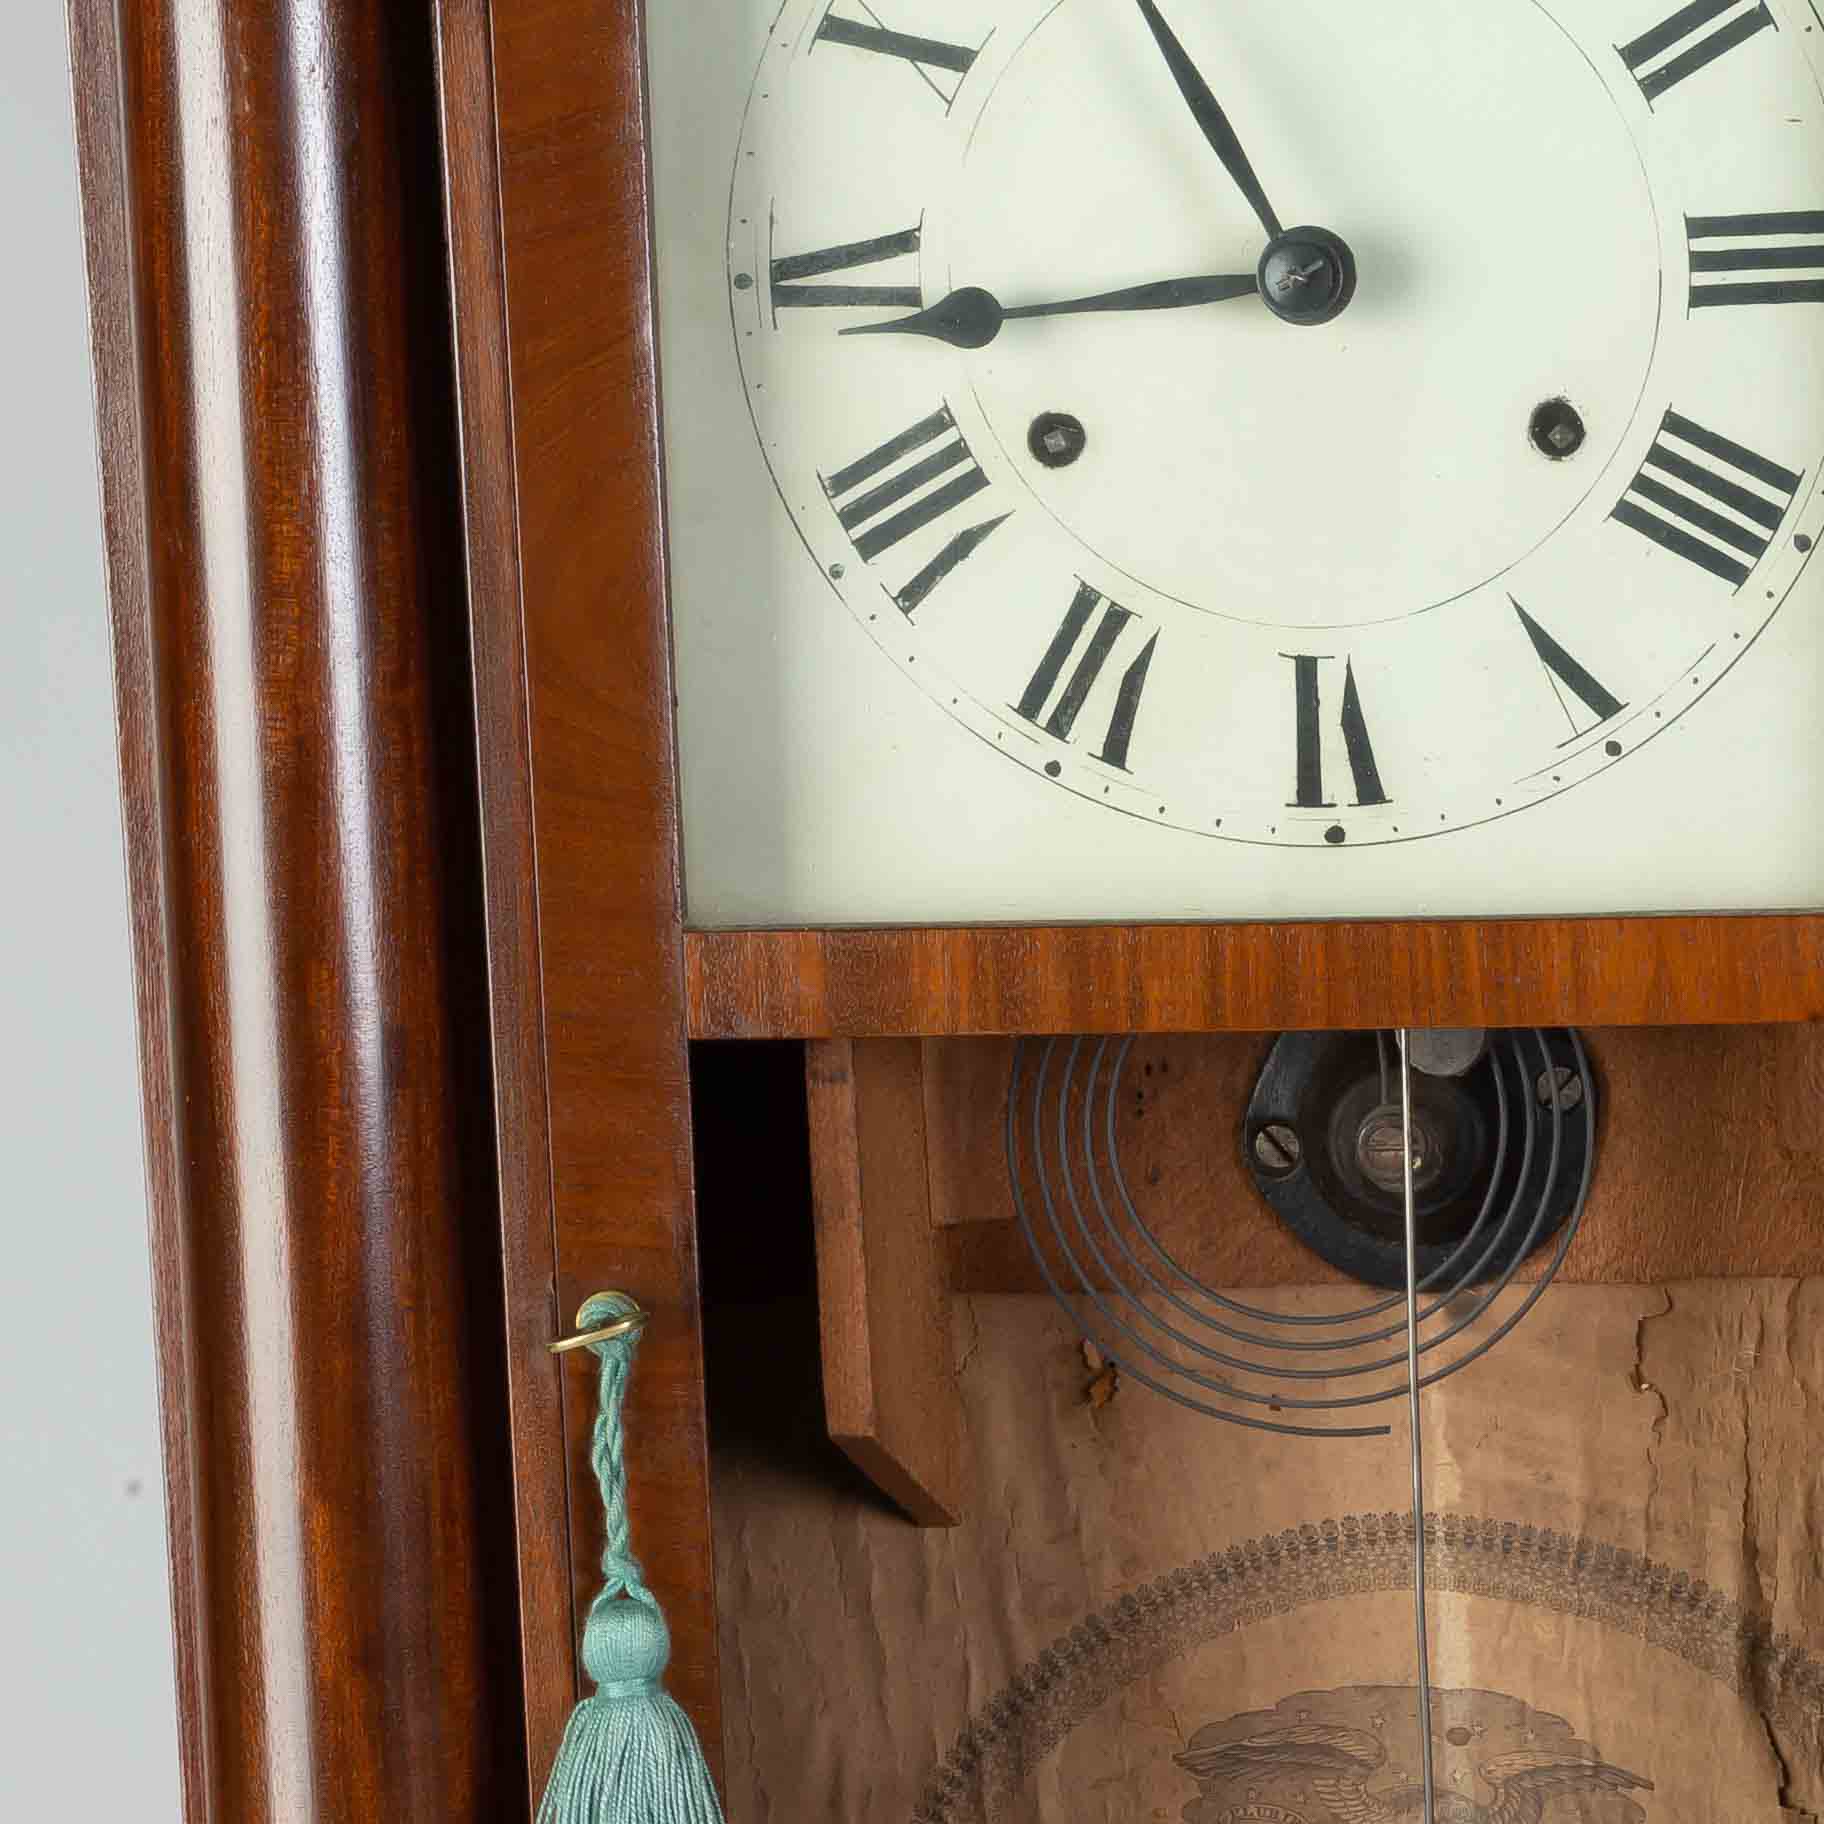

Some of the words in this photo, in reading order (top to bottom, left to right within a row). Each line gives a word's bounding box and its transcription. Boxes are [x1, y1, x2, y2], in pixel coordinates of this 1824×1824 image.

[817, 396, 1017, 626] VIII
[1604, 402, 1807, 597] IIII
[1007, 575, 1160, 776] VII
[1278, 653, 1394, 808] VI
[1506, 593, 1631, 750] V
